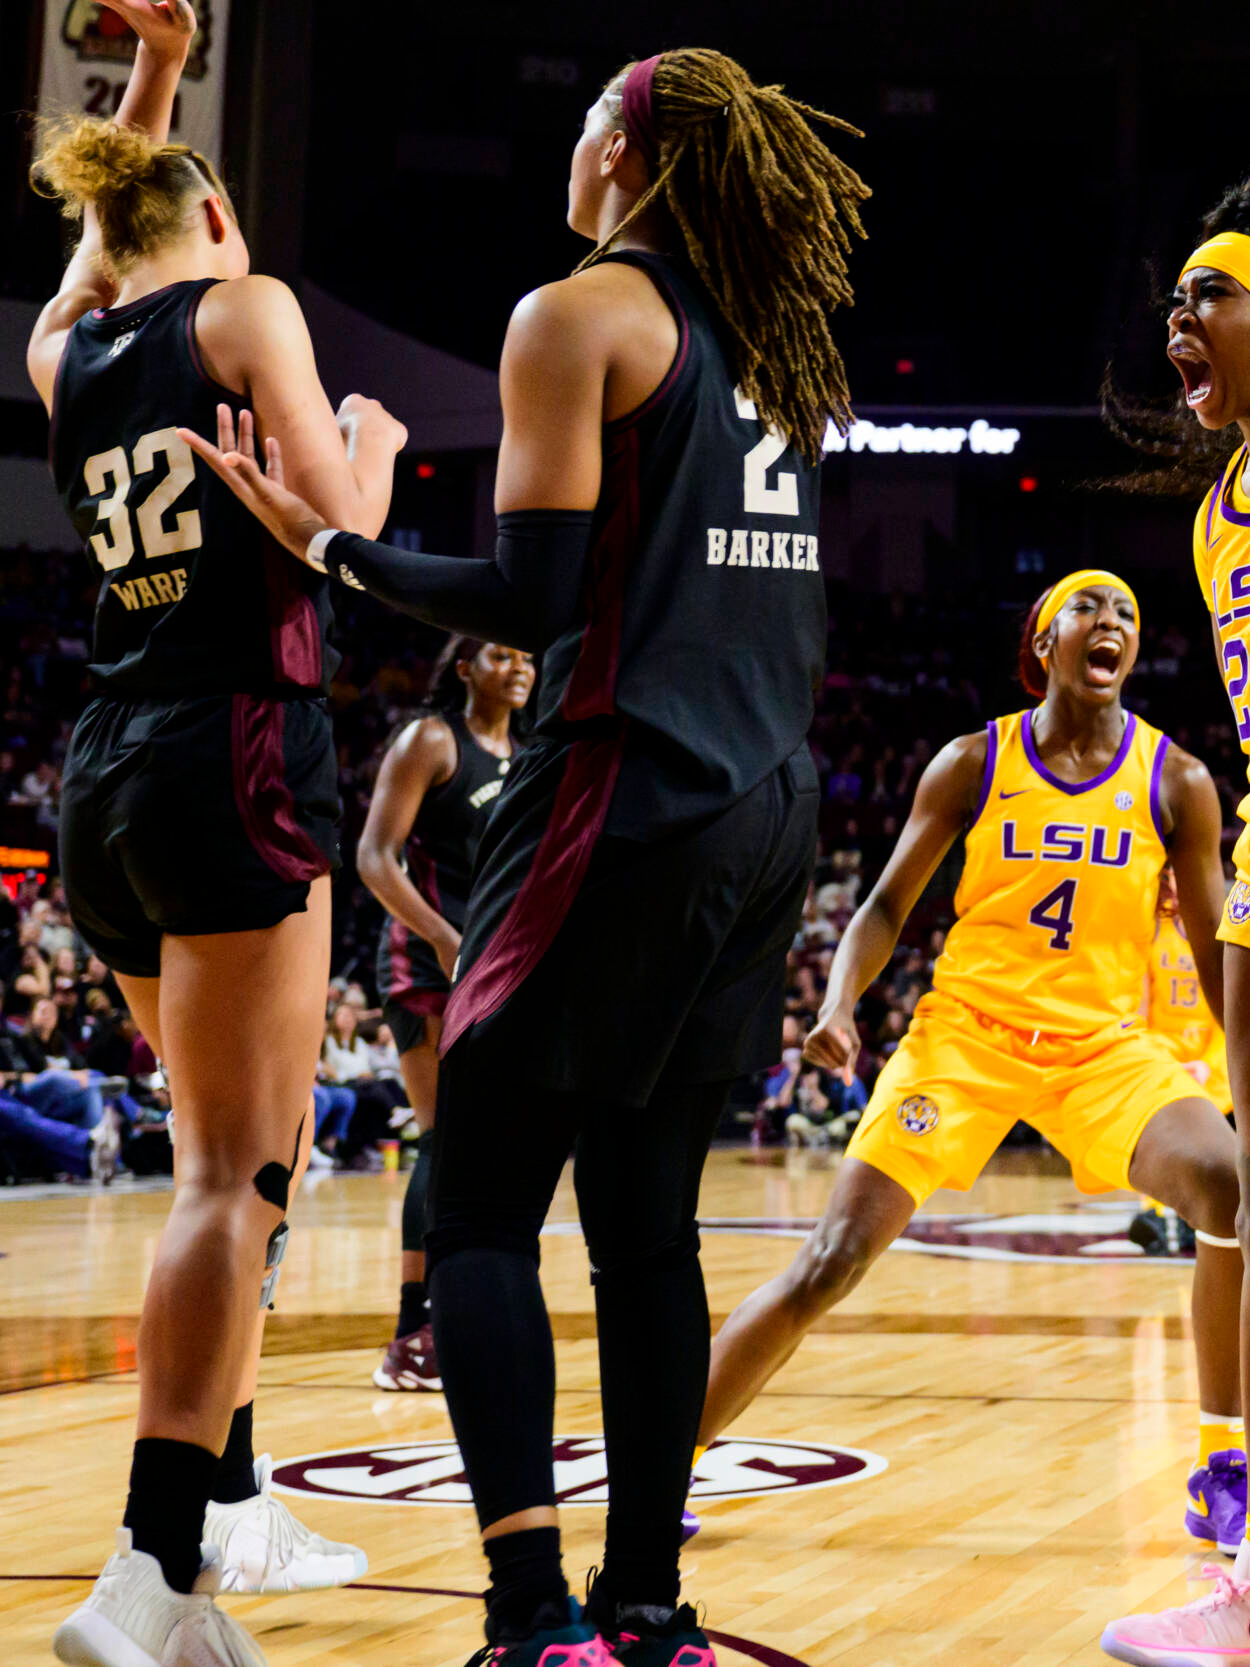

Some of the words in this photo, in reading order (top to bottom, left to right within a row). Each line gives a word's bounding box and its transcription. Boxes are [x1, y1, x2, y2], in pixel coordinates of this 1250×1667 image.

[733, 385, 800, 516] 2
[83, 426, 203, 572] 32
[706, 527, 820, 572] BARKER
[1002, 821, 1134, 868] LSU
[1028, 878, 1079, 951] 4
